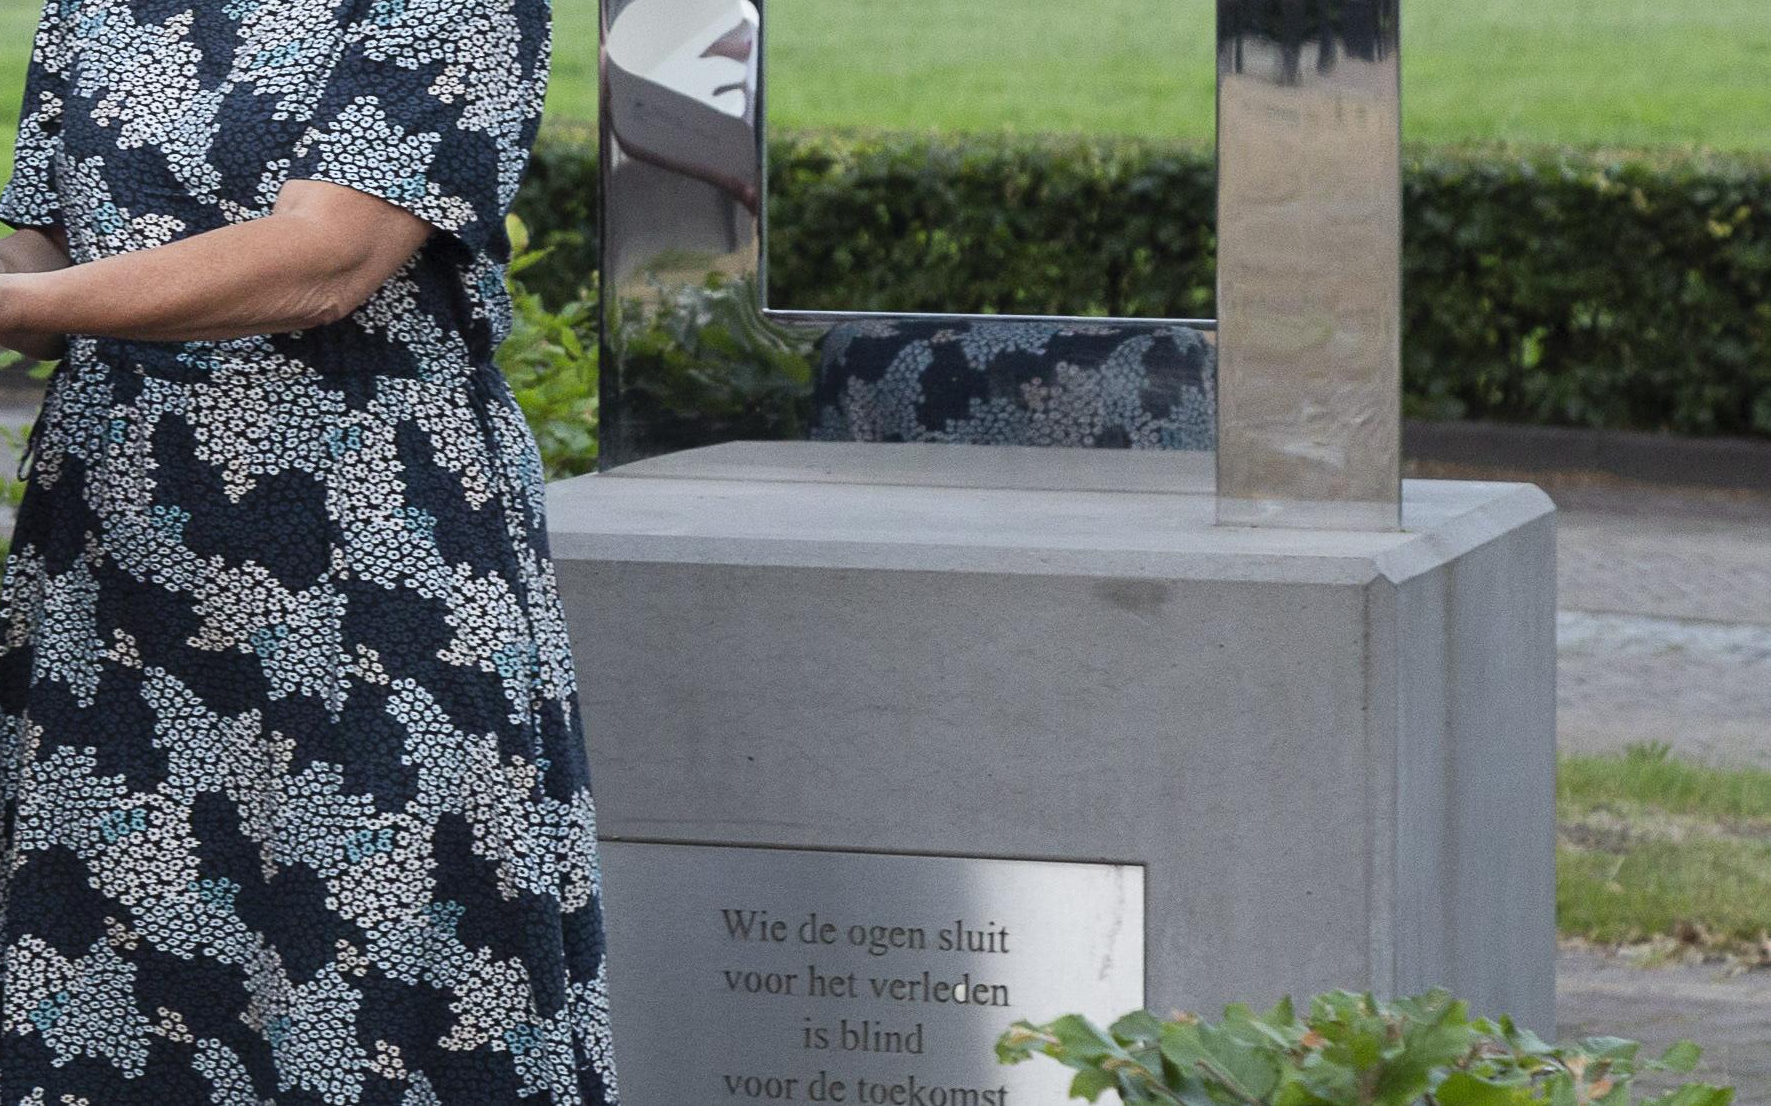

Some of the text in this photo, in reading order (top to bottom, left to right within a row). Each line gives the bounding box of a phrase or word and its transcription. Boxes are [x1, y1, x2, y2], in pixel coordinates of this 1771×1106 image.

[721, 908, 1011, 957] Wie de ogen sluit
[723, 964, 1011, 1008] voor het verleden
[802, 1016, 926, 1055] is blind
[723, 1074, 799, 1100] voor
[808, 1070, 846, 1102] de
